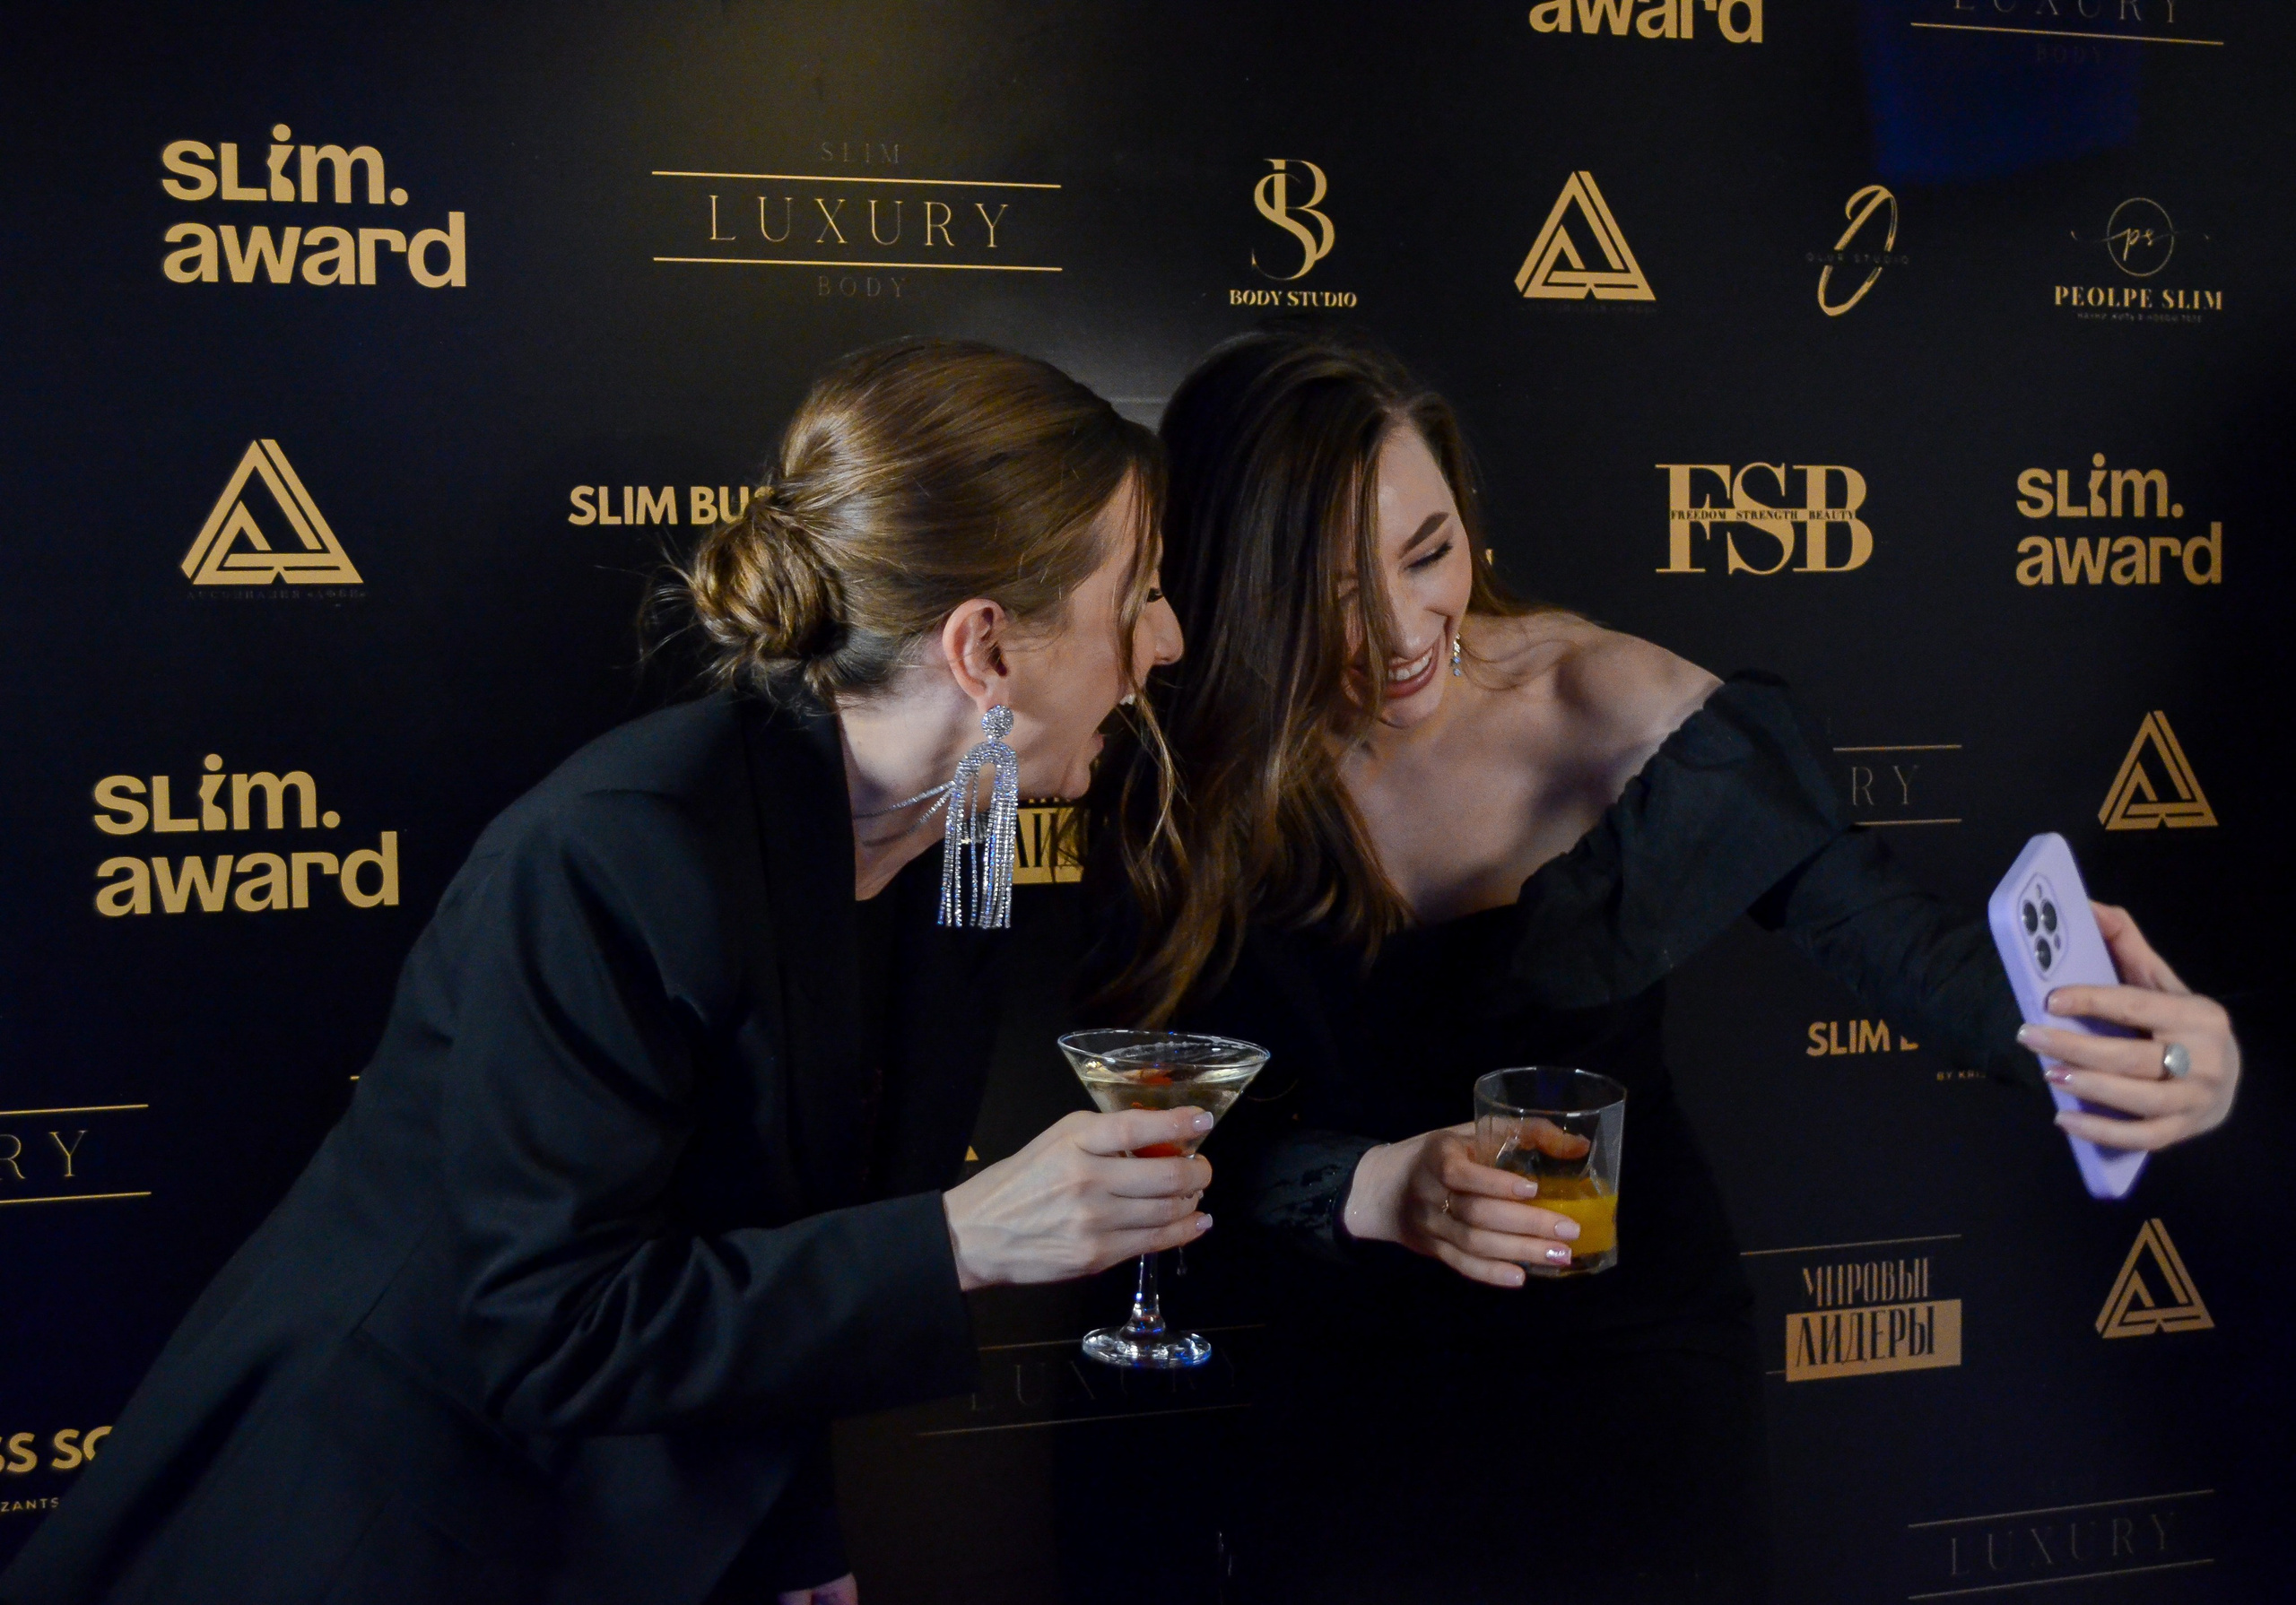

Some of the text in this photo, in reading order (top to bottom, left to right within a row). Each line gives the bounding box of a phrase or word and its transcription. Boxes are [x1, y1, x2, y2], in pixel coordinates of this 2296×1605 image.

[821, 141, 900, 165] SLIM
[709, 195, 1010, 248] LUXURY
[162, 211, 465, 288] award
[817, 275, 907, 299] BODY
[1230, 289, 1359, 308] BODY STUDIO
[2055, 284, 2222, 311] PEOLPE SLIM
[568, 485, 774, 525] SLIM BU
[1655, 462, 1874, 576] FSB
[1670, 509, 1854, 520] FREEDOM STRENGTH BEAUTY
[2015, 522, 2223, 586] award
[95, 830, 400, 917] award
[1805, 1019, 1891, 1057] SLIM
[1796, 1306, 1935, 1367] ЛИДЕРЫ
[1950, 1512, 2177, 1576] LUXURY
